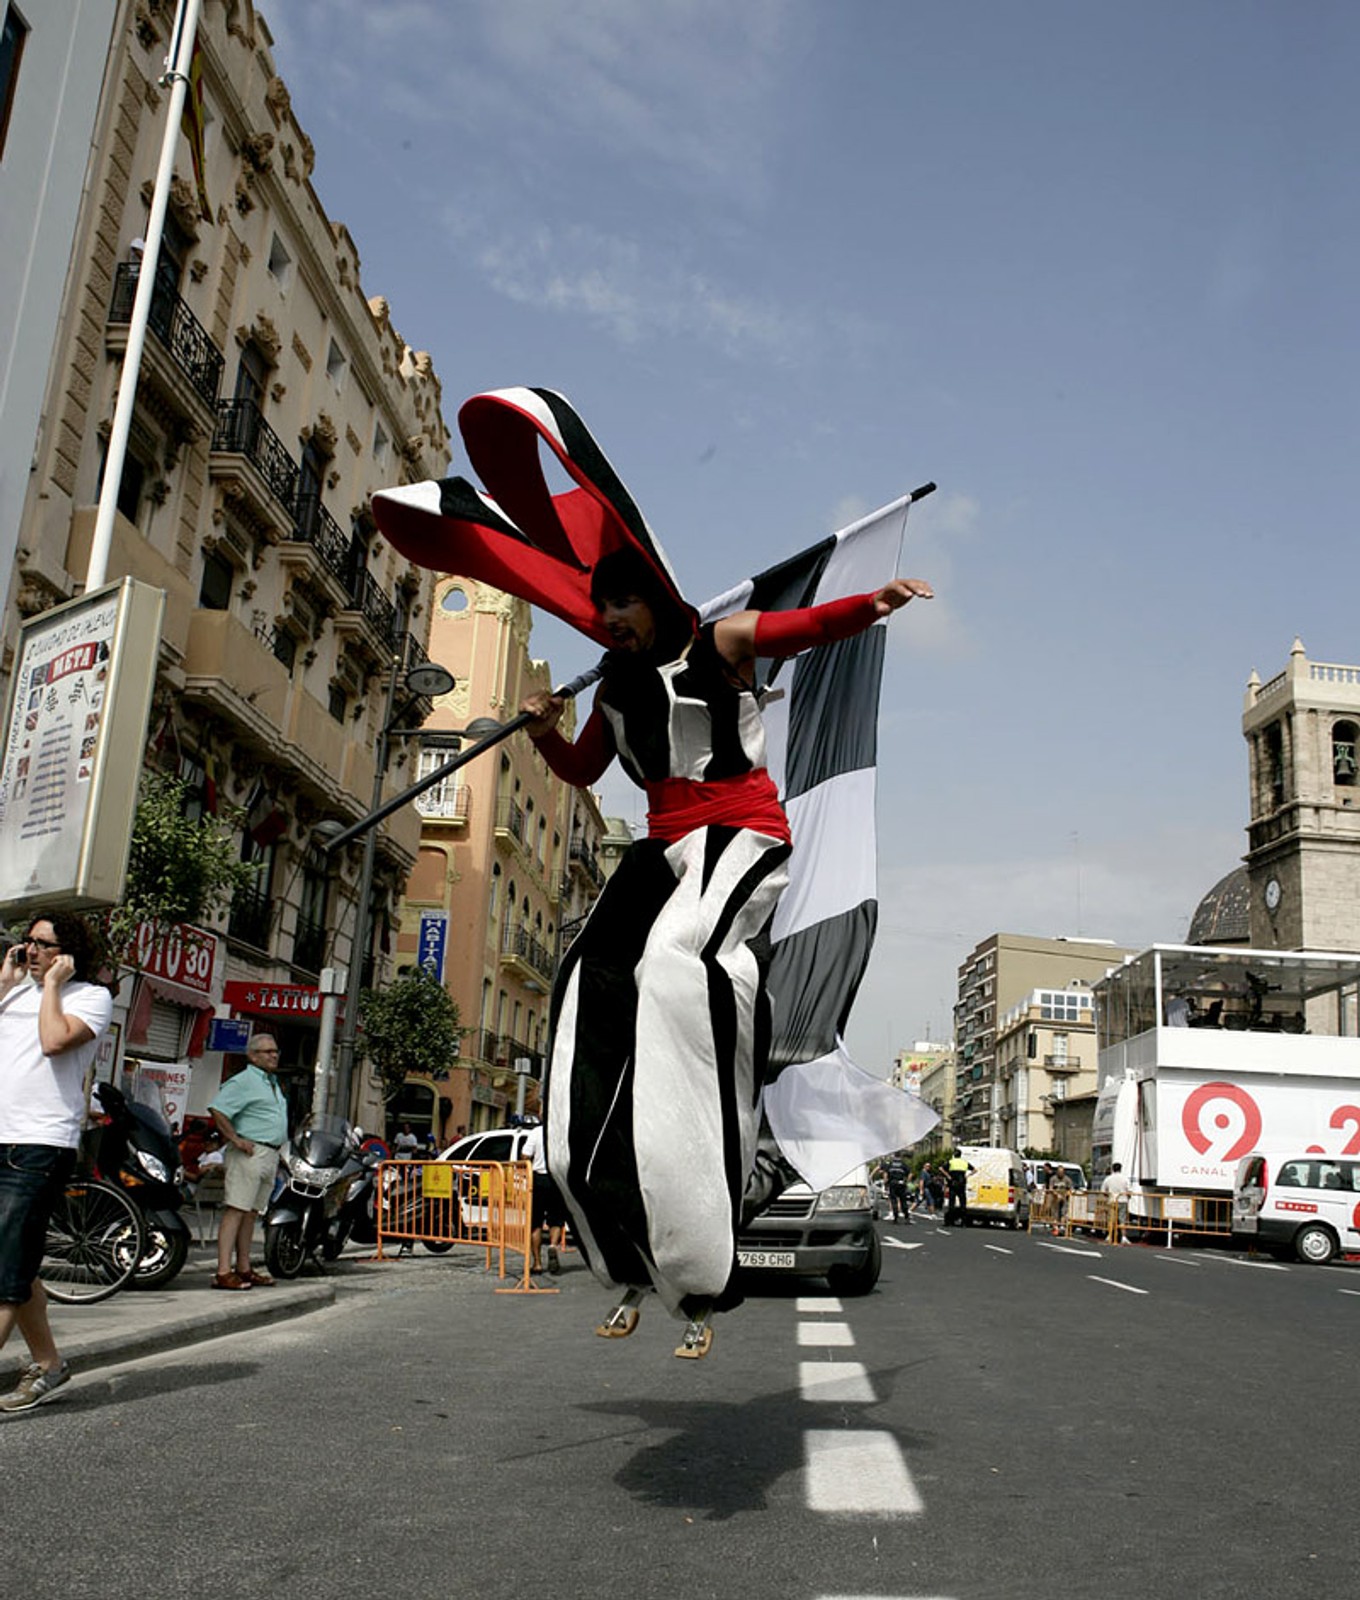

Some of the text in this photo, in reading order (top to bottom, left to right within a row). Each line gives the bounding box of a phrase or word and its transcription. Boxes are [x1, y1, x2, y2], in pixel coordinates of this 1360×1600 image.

[52, 646, 91, 679] META
[186, 944, 210, 978] 30
[259, 988, 319, 1011] TATTOO
[1180, 1165, 1227, 1177] CANAL
[739, 1253, 792, 1266] 769 CHG
